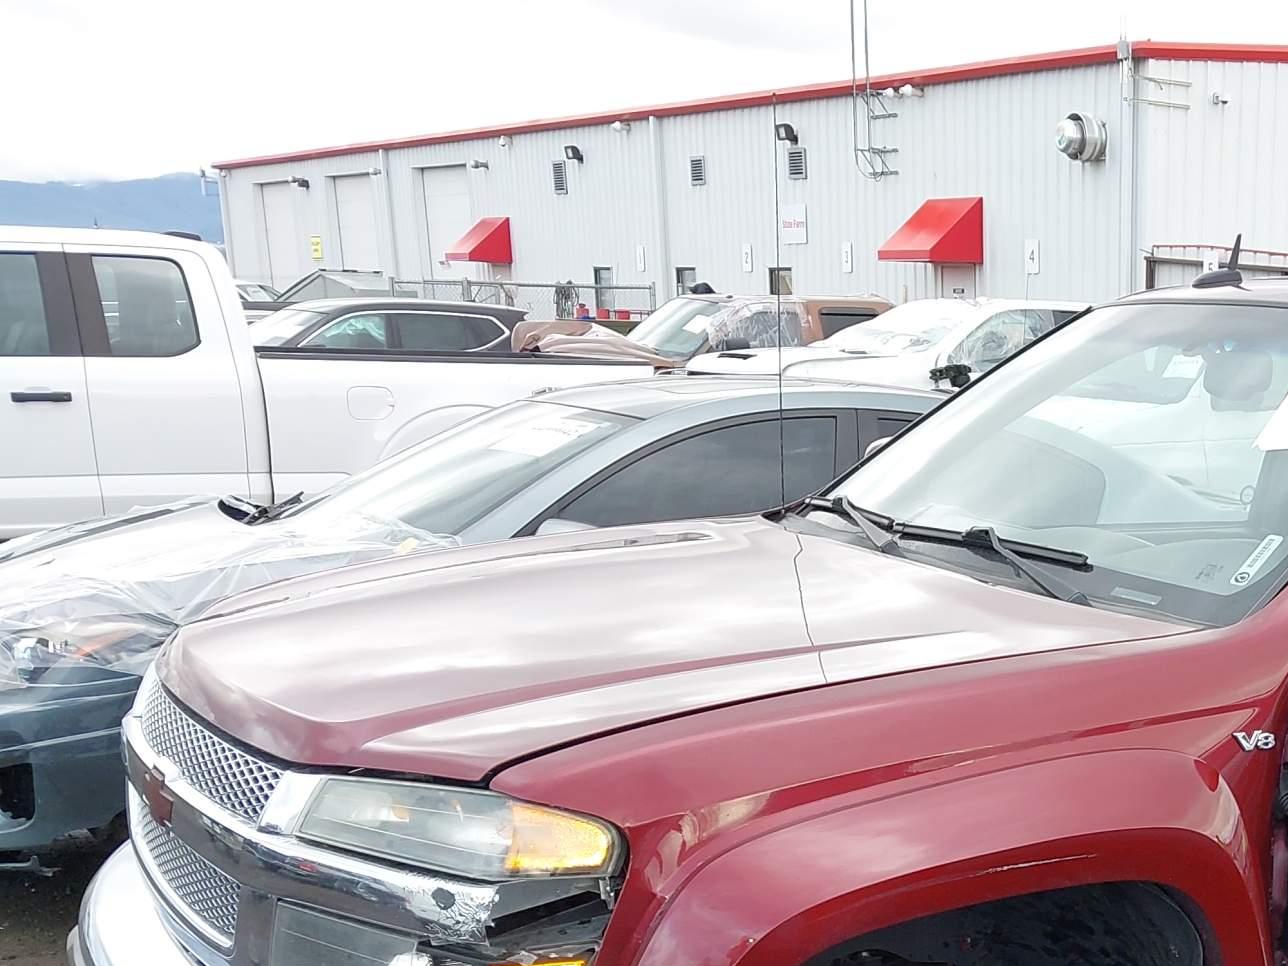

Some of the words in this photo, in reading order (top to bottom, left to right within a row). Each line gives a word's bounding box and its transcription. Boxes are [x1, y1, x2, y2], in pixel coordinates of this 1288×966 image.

[744, 251, 749, 265] 2
[1028, 248, 1035, 265] 4
[1232, 729, 1276, 752] V8
